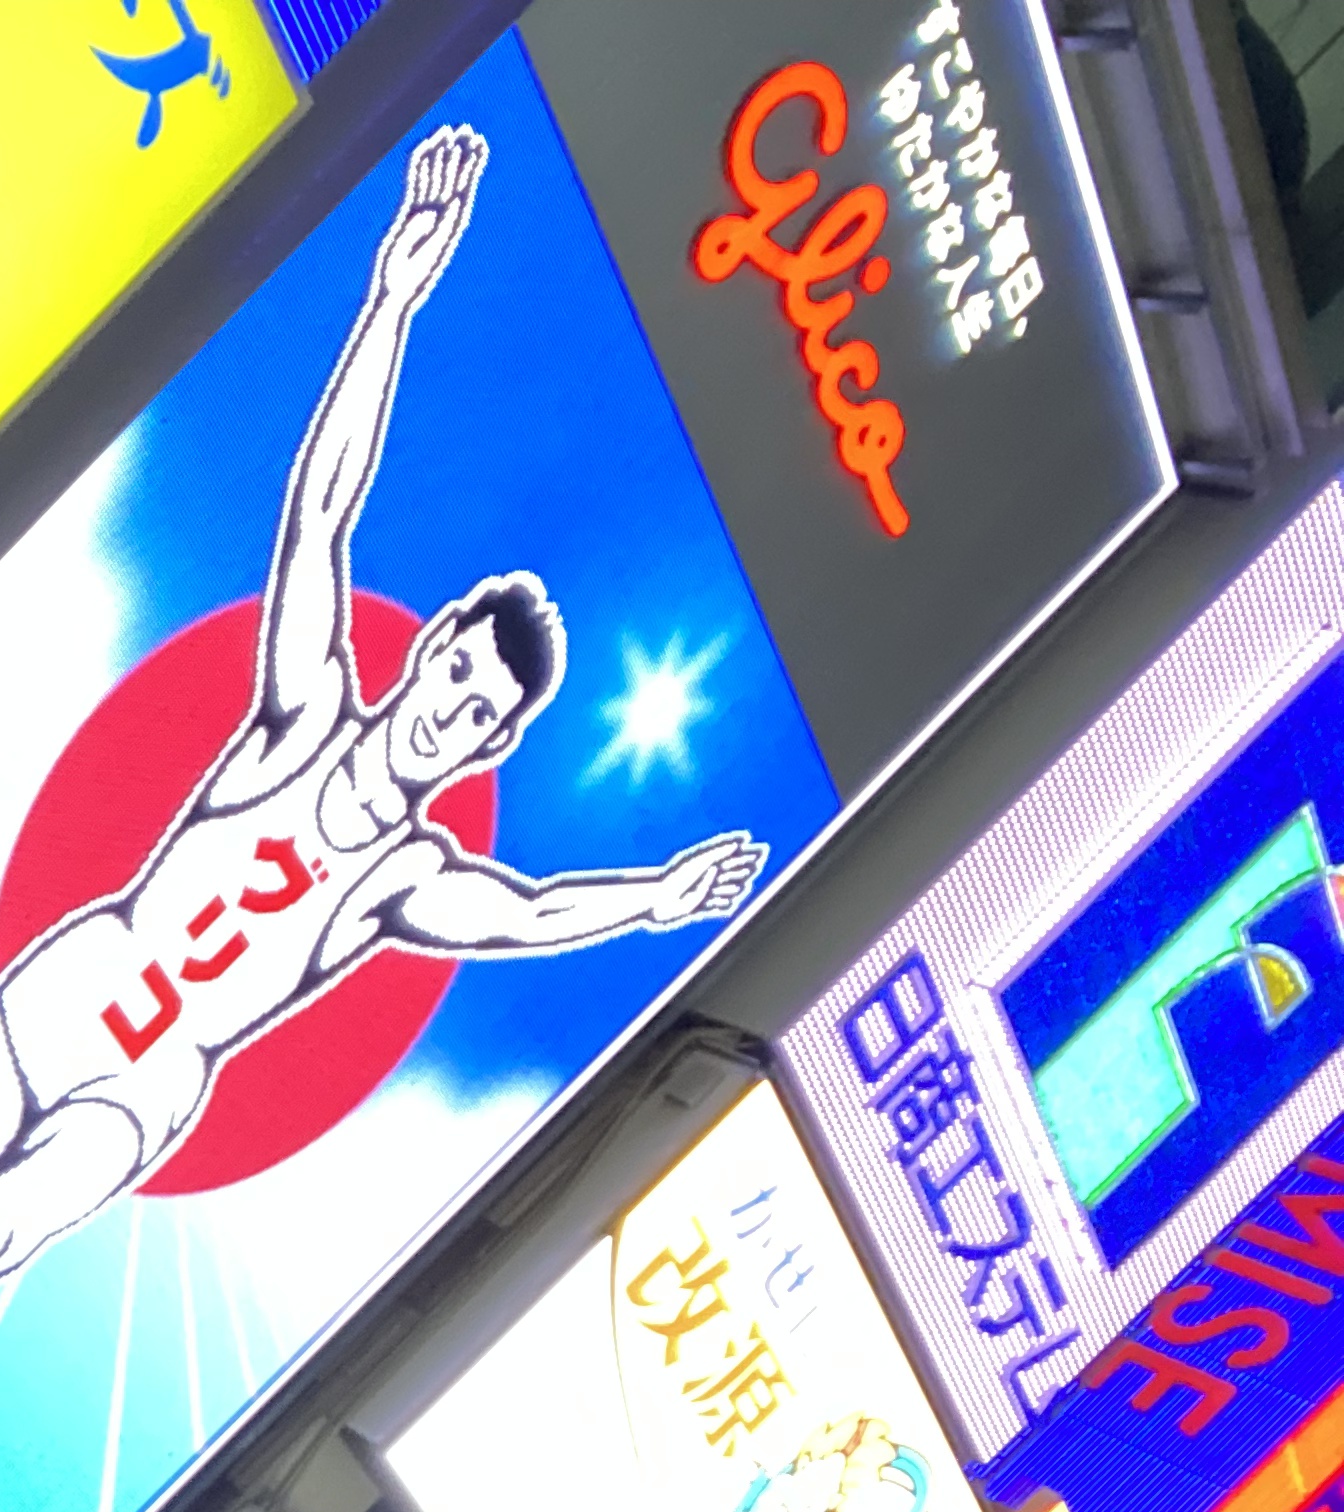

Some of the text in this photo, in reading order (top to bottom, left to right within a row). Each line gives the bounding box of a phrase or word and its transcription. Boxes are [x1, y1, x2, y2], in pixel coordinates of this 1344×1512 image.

[695, 61, 909, 537] Glico
[880, 64, 994, 352] ゆたかな人生
[100, 836, 330, 1064] グリコ
